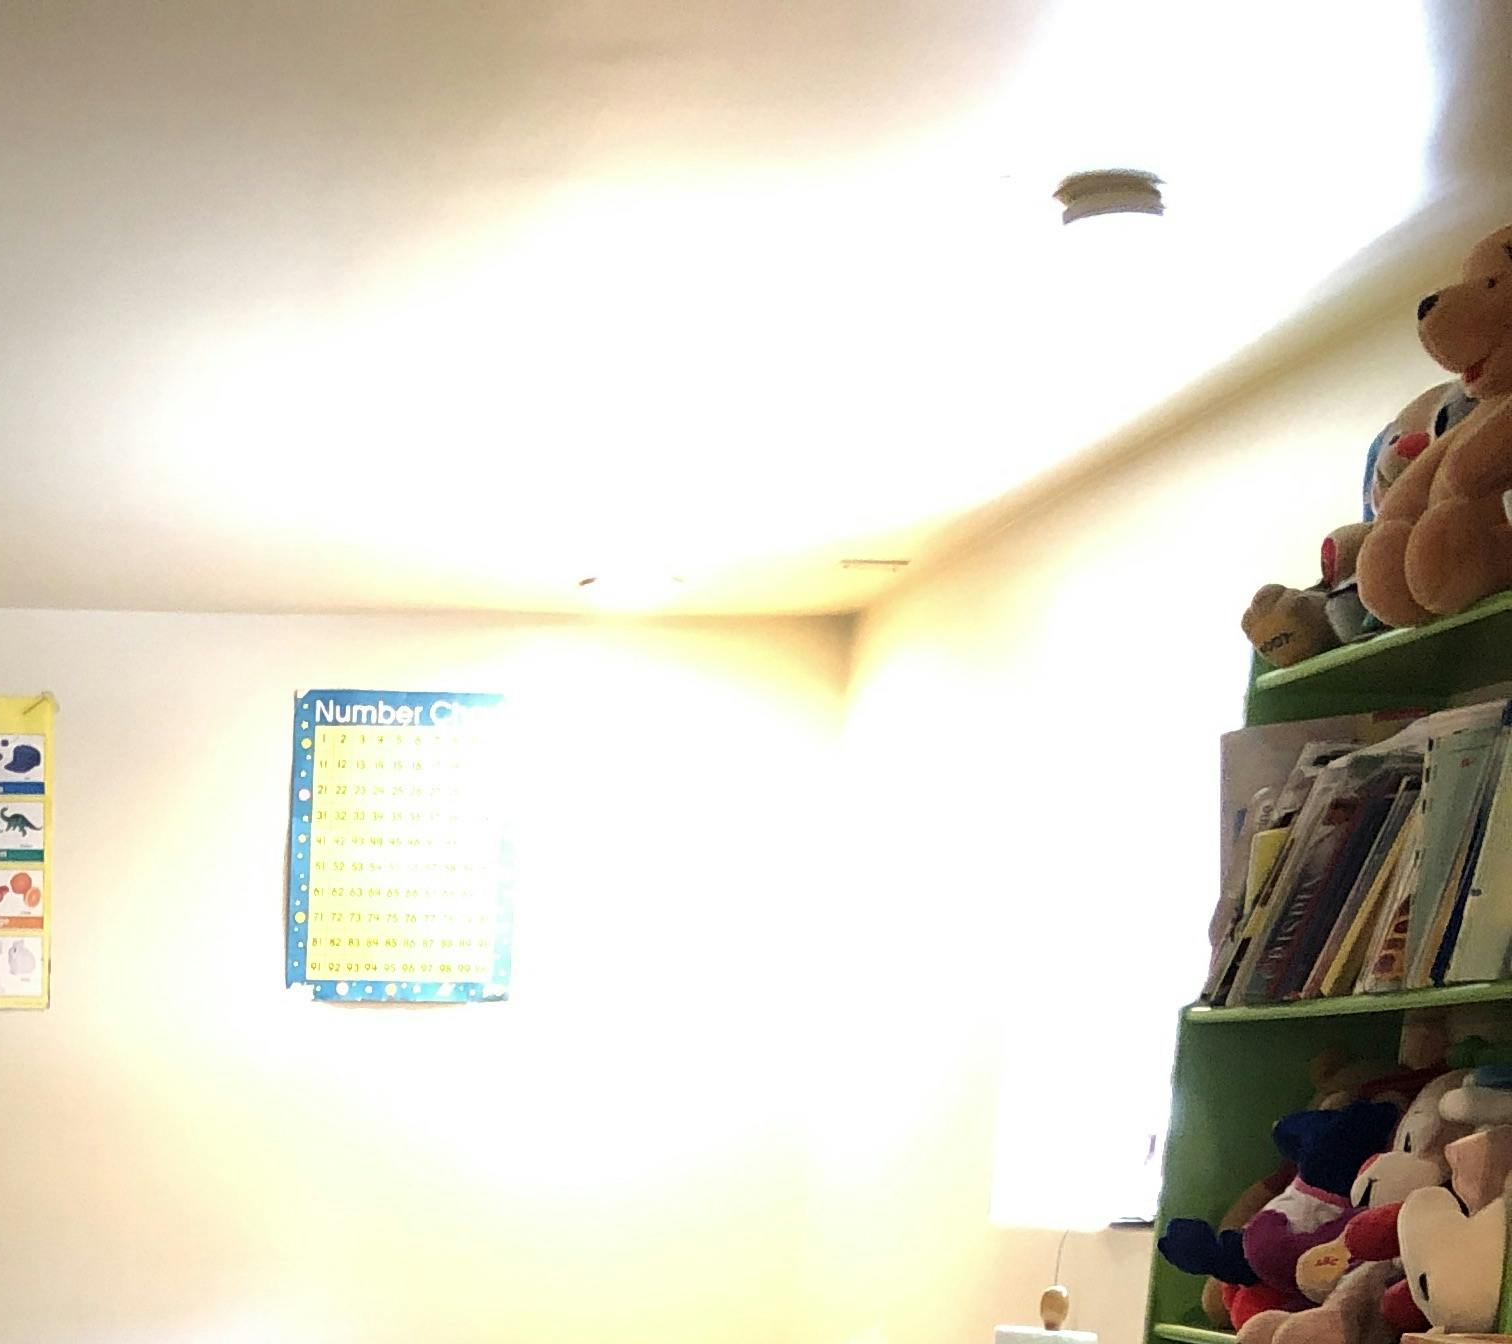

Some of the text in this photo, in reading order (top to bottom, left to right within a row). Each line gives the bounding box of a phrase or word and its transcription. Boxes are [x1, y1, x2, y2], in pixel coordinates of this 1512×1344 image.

[315, 699, 424, 726] Number
[340, 734, 346, 744] 2
[317, 784, 328, 795] 21
